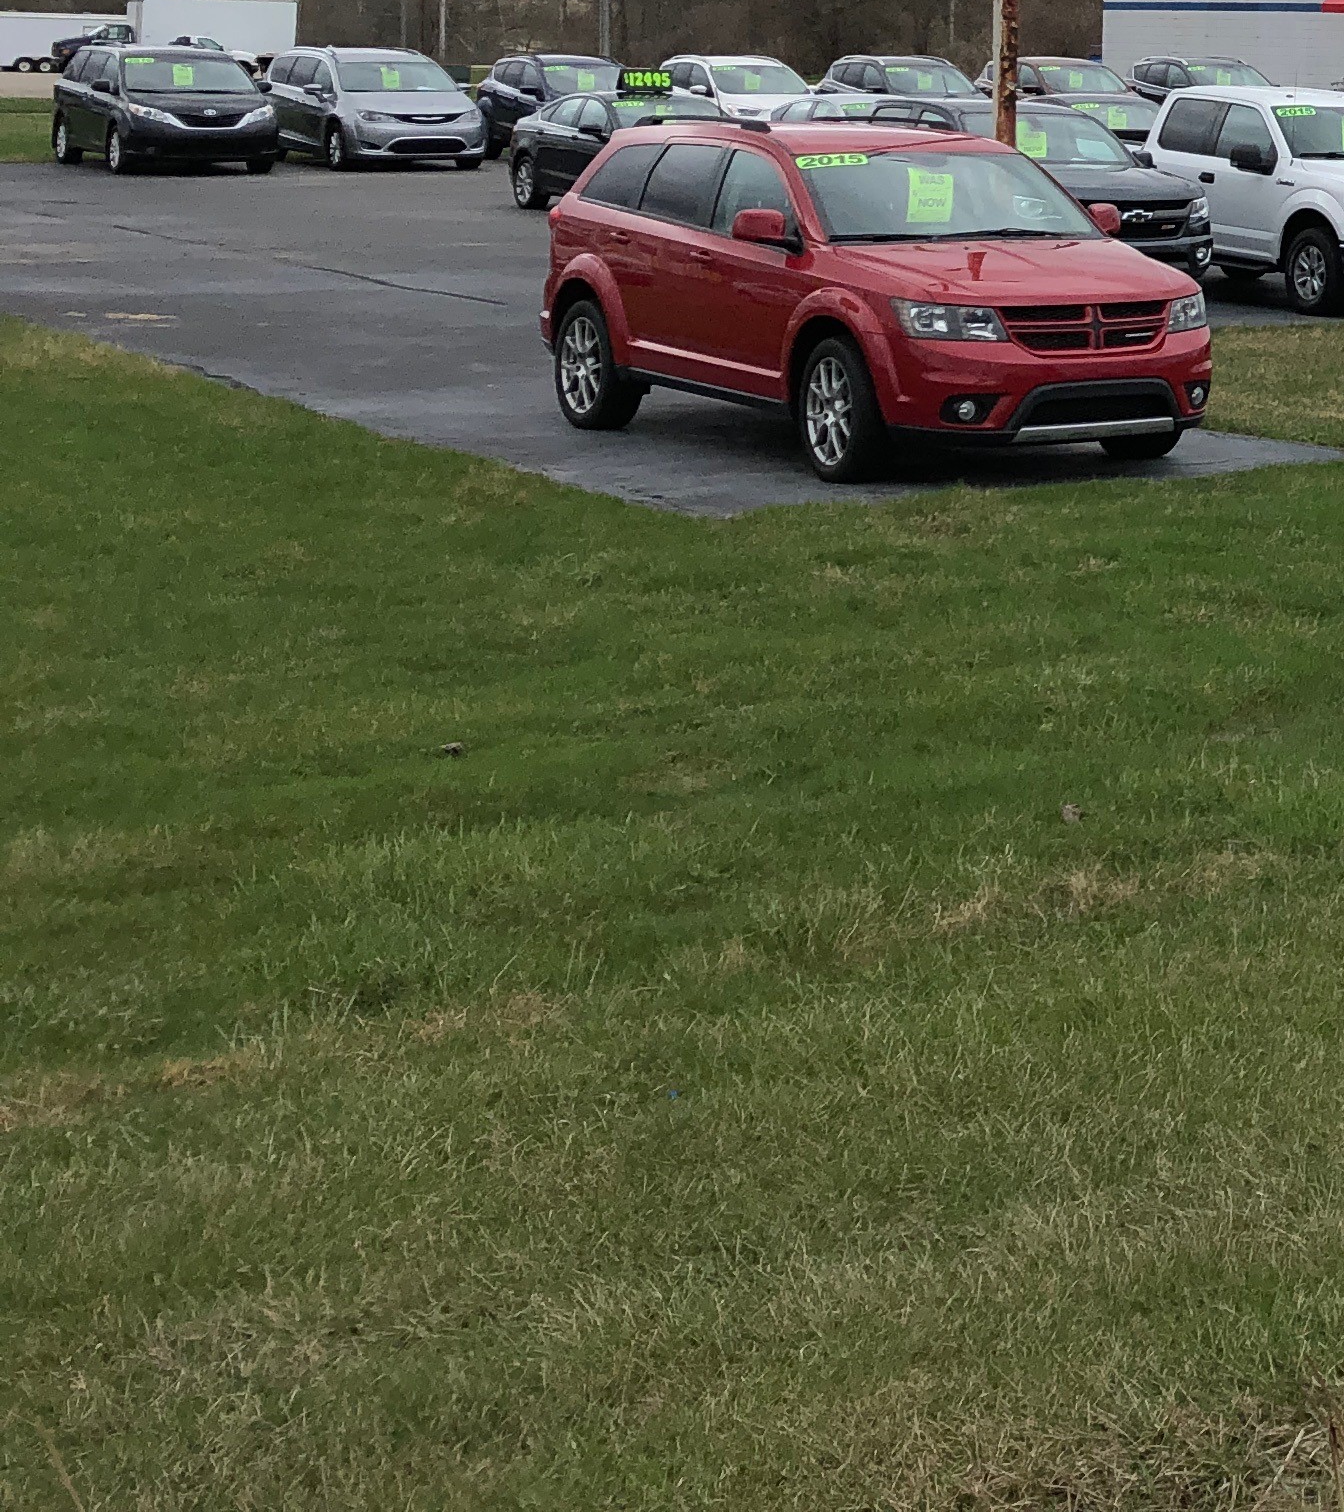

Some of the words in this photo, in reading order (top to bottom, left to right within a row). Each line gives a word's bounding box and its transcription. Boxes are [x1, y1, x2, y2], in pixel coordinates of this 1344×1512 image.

[1280, 107, 1313, 117] 2015
[802, 155, 862, 168] 2015
[919, 175, 945, 185] WAS
[917, 197, 946, 208] NOW
